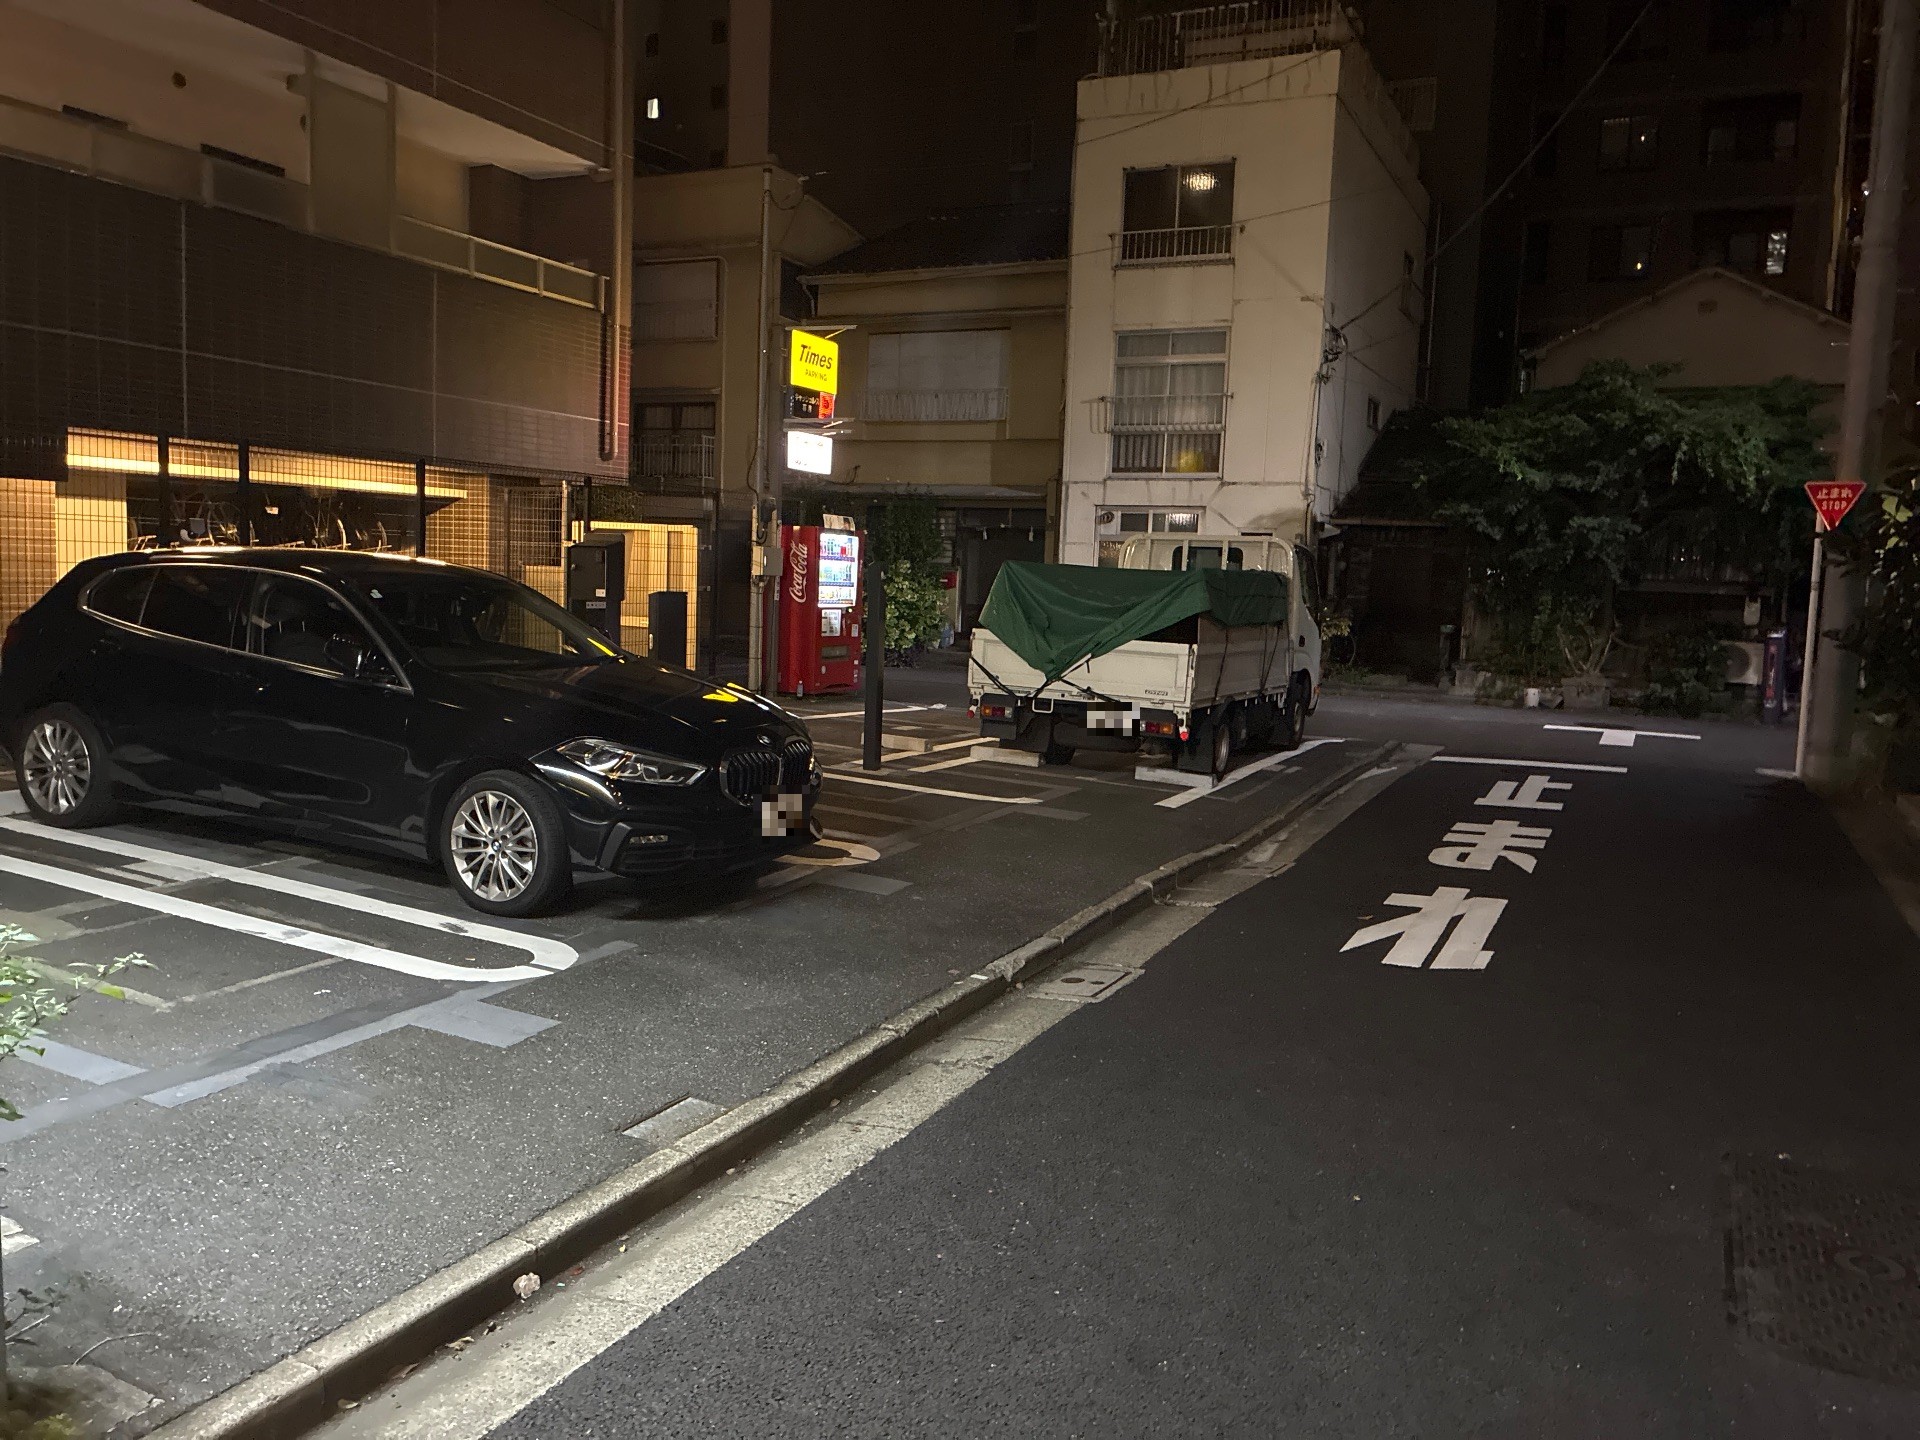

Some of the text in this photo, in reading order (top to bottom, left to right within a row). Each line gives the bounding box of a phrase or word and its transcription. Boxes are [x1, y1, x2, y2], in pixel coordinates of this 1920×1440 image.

[799, 344, 833, 370] Times
[805, 369, 828, 381] PARKING
[1817, 487, 1853, 499] 止まれ
[1822, 501, 1847, 511] STOP
[1339, 774, 1573, 970] 止まれ
